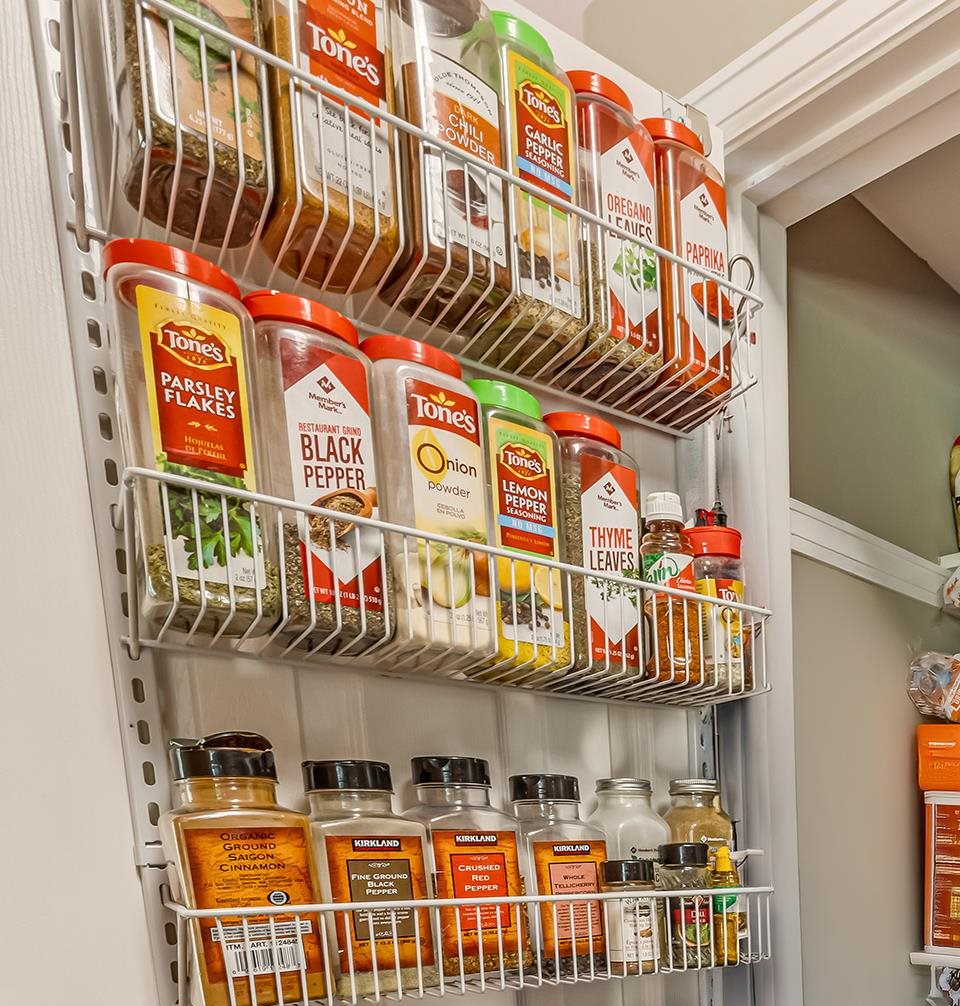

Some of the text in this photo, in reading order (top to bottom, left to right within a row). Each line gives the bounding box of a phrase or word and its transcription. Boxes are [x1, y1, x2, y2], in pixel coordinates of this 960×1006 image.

[306, 21, 380, 86] Tone's
[454, 103, 480, 126] DARK
[523, 88, 561, 124] Tone's
[448, 113, 484, 142] CHILI
[436, 124, 496, 167] POWDER
[525, 124, 564, 156] GARLIC
[525, 137, 564, 170] PEPPER
[525, 150, 565, 178] SEASONING
[529, 164, 542, 176] NO
[607, 193, 653, 225] OREGANO
[686, 241, 726, 273] PAPRIKA
[163, 328, 225, 363] Tone's
[159, 371, 237, 404] PARSLEY
[163, 388, 237, 420] FLAKES
[308, 391, 347, 409] Member's
[318, 402, 339, 414] Mark
[411, 392, 477, 434] Tone's
[298, 422, 363, 436] RESTAURANT GRIND
[299, 433, 365, 465] BLACK
[416, 443, 478, 478] Onion
[504, 449, 543, 474] Tone's
[303, 464, 367, 491] PEPPER
[428, 480, 471, 499] powder
[502, 479, 549, 502] LEMON
[436, 502, 466, 515] CEBOLLA
[505, 493, 548, 516] PEPPER
[506, 506, 548, 523] SEASONING
[589, 526, 633, 550] THYME
[589, 550, 635, 571] LEAVES
[220, 832, 276, 841] ORGANIC
[222, 843, 277, 851] GROUND
[353, 839, 400, 848] KIRKLAND
[455, 835, 498, 843] KIRKLAND
[553, 844, 590, 852] KIRKLAND
[219, 863, 287, 872] CINNAMON
[228, 853, 275, 861] SAIGON
[458, 864, 501, 872] CRUSHED
[464, 884, 499, 892] PEPPER
[471, 874, 490, 882] RED
